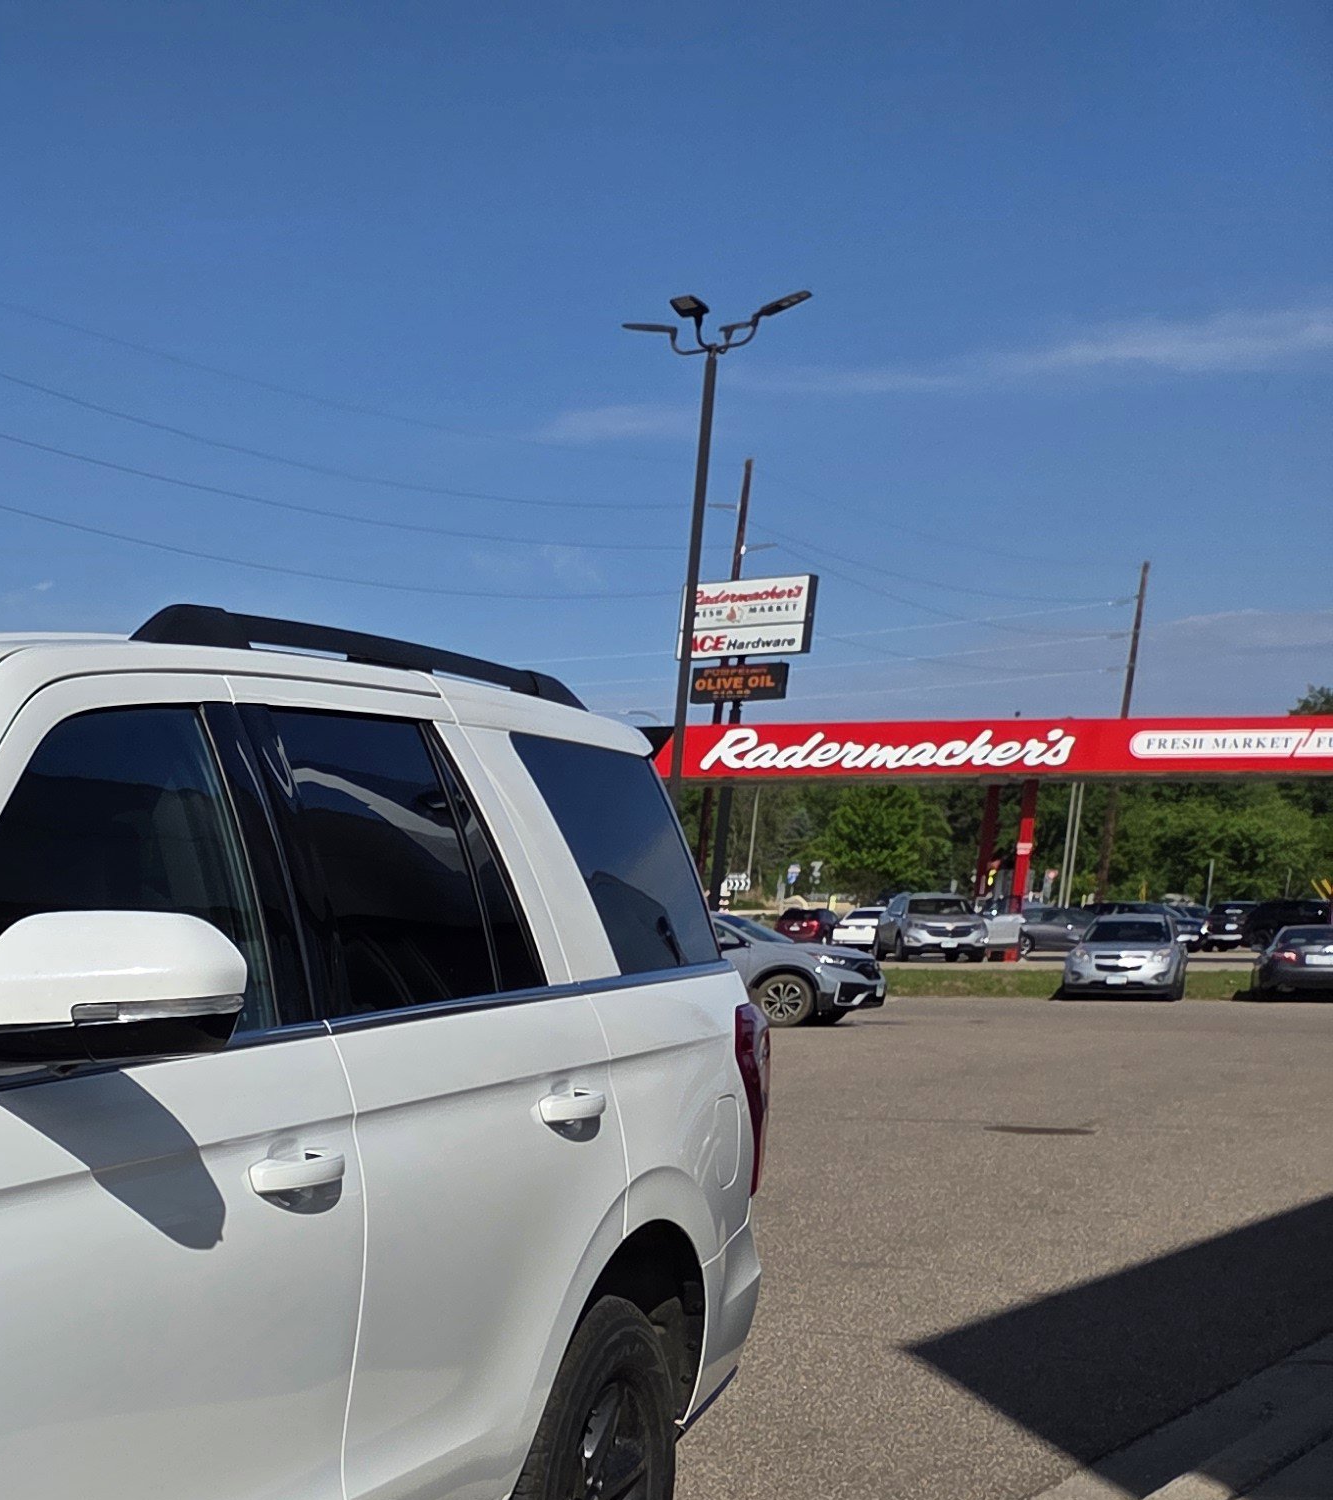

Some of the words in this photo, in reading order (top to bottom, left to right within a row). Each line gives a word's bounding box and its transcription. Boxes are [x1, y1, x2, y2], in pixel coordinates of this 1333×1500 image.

[694, 609, 723, 618] ESH
[748, 603, 797, 614] MARKET
[726, 637, 796, 651] Hardware
[694, 676, 744, 691] OLIVE
[748, 675, 776, 688] OIL
[699, 728, 1076, 770] Radermacher's
[1146, 737, 1204, 750] FRESH
[1212, 736, 1293, 750] MARKET
